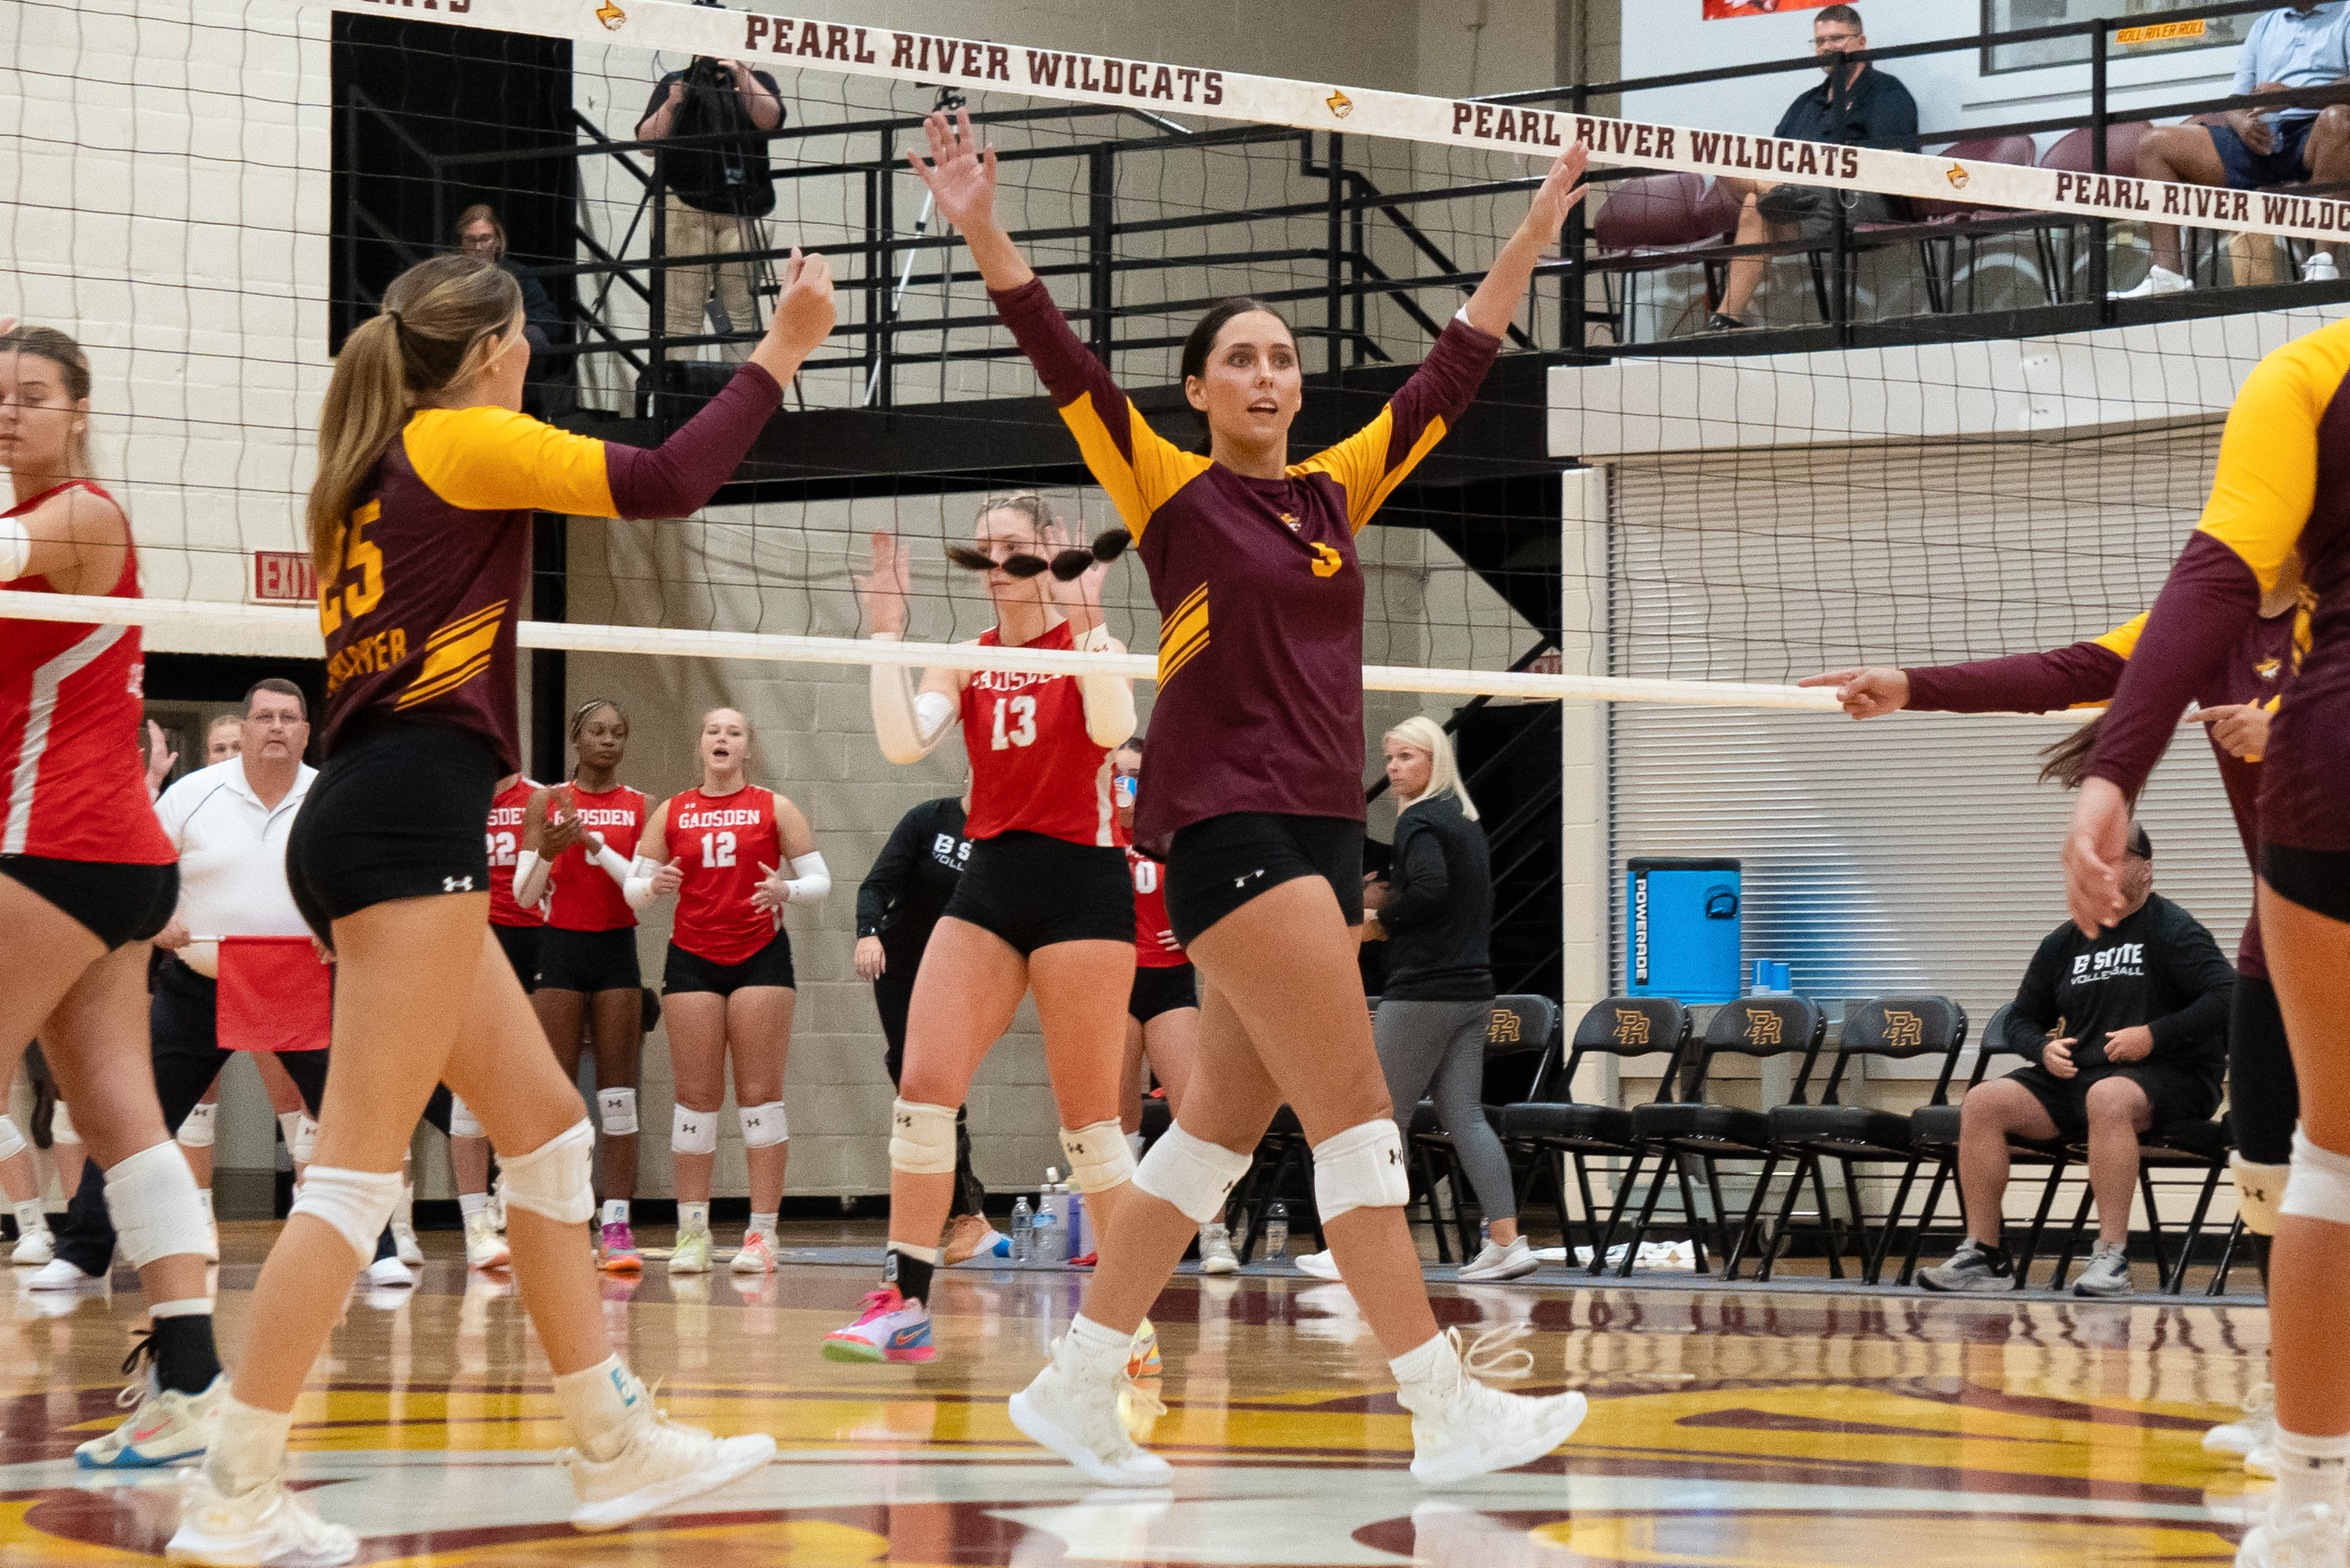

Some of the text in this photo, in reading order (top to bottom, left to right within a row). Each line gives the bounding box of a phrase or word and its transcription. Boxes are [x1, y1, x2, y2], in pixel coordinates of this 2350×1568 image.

[745, 14, 1223, 105] PEARL RIVER WILDCATS
[1452, 102, 1858, 179] PEARL RIVER WILDCATS
[2056, 172, 2150, 211] PEARL
[2163, 185, 2249, 222] RIVER
[991, 695, 1036, 751] 13
[554, 809, 635, 827] GDSDEN
[678, 809, 760, 829] GADSDEN
[701, 831, 736, 868] 12
[1635, 879, 1648, 980] POWERADE
[2070, 965, 2145, 985] VOLLEBALL
